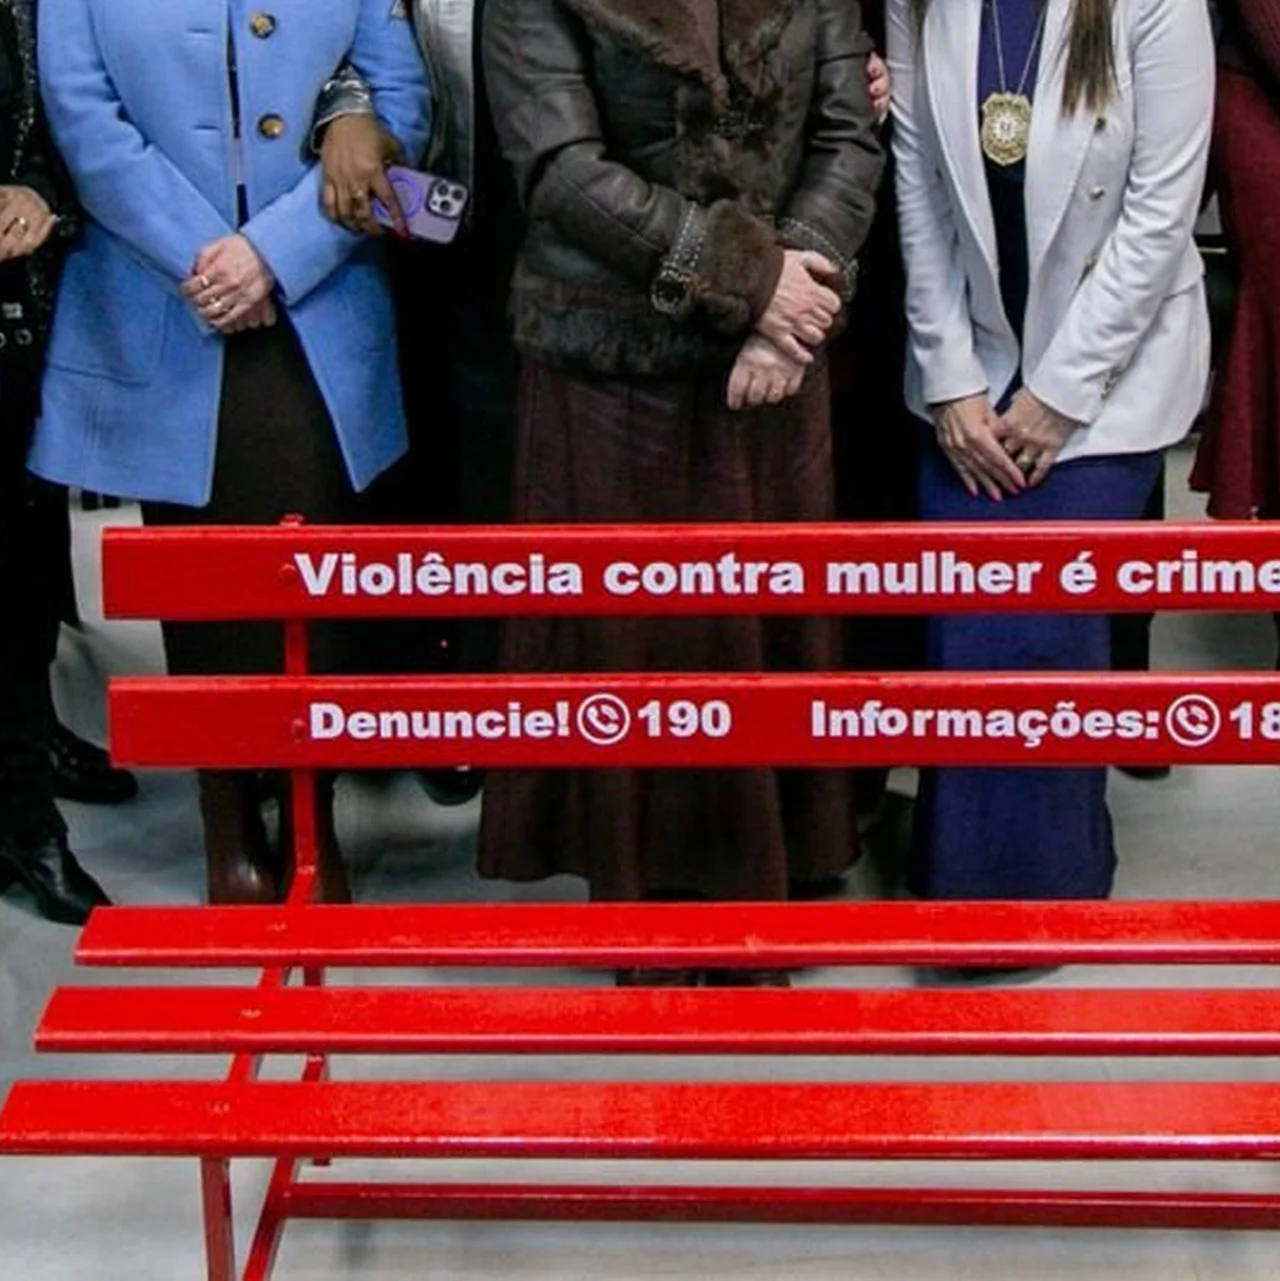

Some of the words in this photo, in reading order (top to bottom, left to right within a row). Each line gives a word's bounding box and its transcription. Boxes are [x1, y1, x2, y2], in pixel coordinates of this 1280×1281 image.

[294, 552, 584, 595] Violência
[603, 553, 805, 595] contra
[826, 551, 1043, 595] mulher
[1060, 551, 1097, 594] é
[309, 701, 570, 739] Denuncie!
[637, 700, 733, 738] 190
[811, 700, 1160, 748] Informações:
